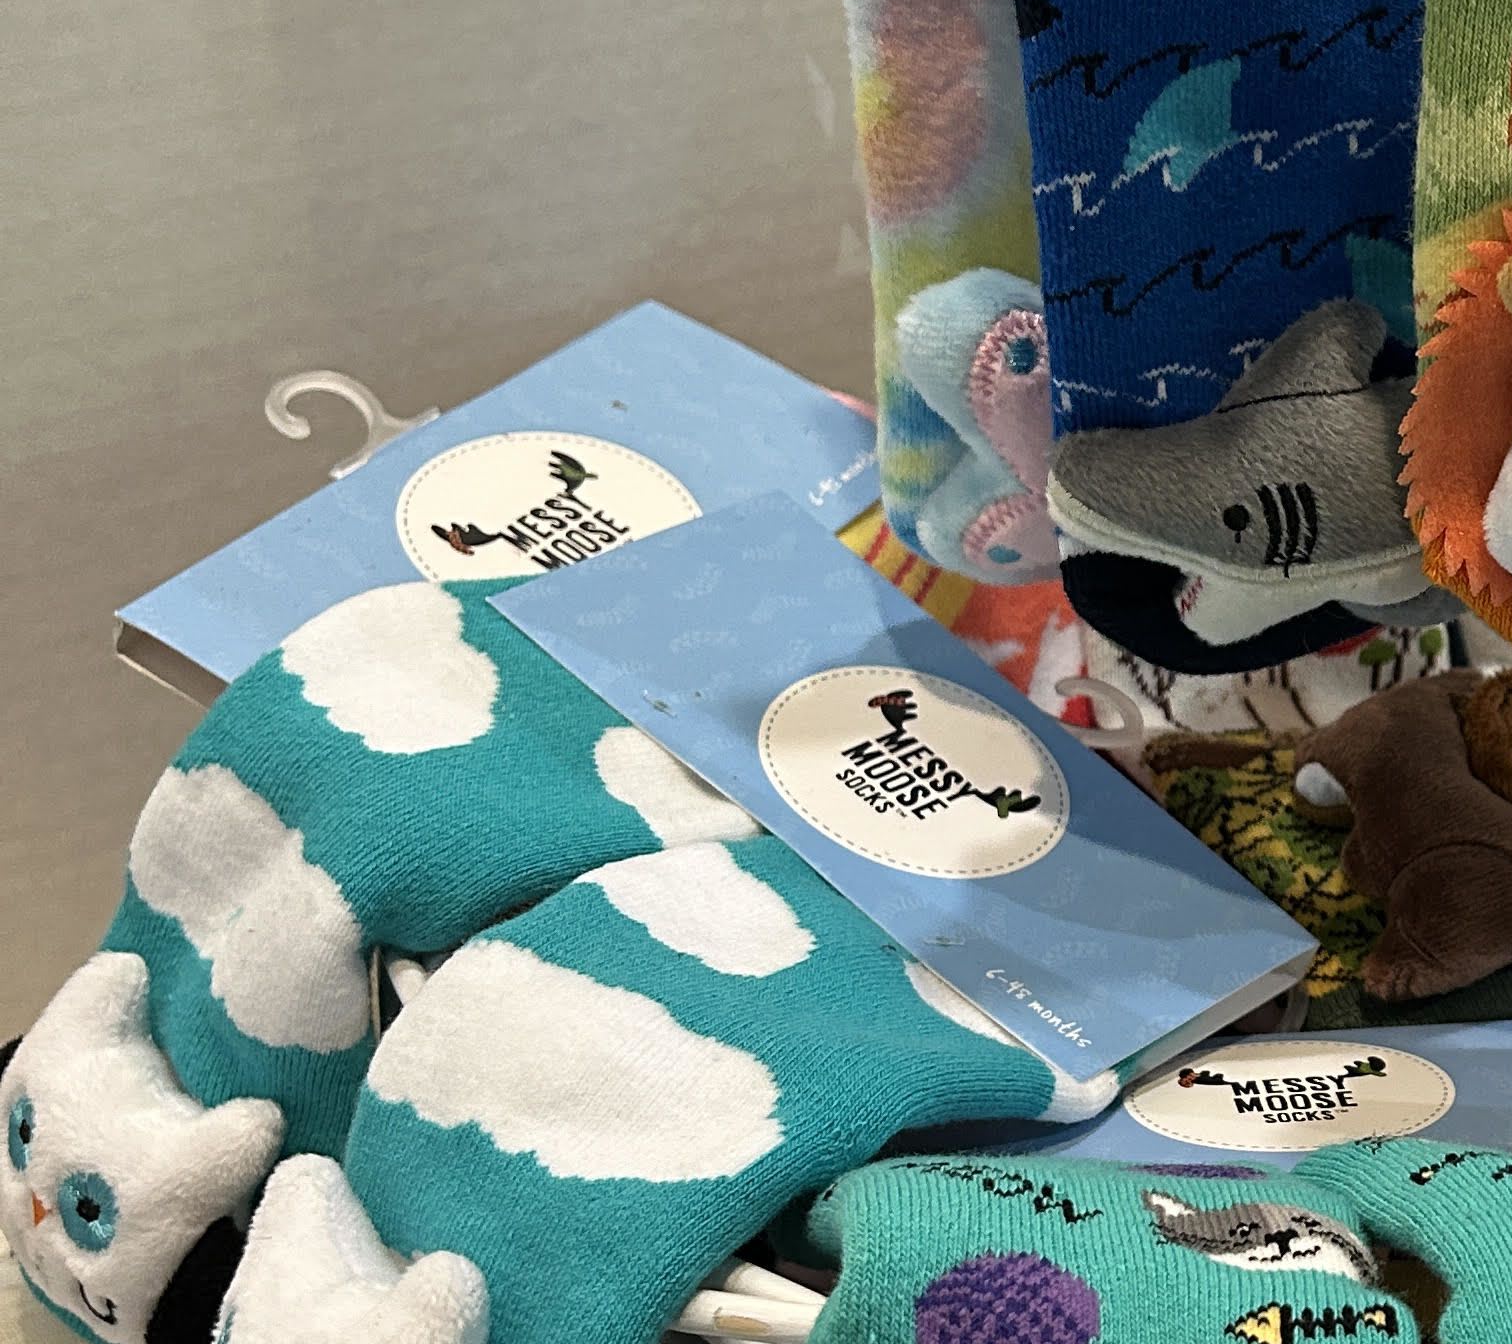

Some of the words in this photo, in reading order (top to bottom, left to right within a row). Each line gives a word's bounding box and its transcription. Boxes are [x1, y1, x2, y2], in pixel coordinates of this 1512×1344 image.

[500, 492, 593, 554] MESSY
[530, 509, 631, 570] MOOSE
[841, 740, 949, 820] MOOSE
[875, 729, 973, 802] MESSY
[985, 968, 1033, 1000] 6-48
[1027, 1000, 1093, 1048] months
[1231, 1074, 1346, 1097] MESSY
[1233, 1090, 1359, 1114] MOOSE
